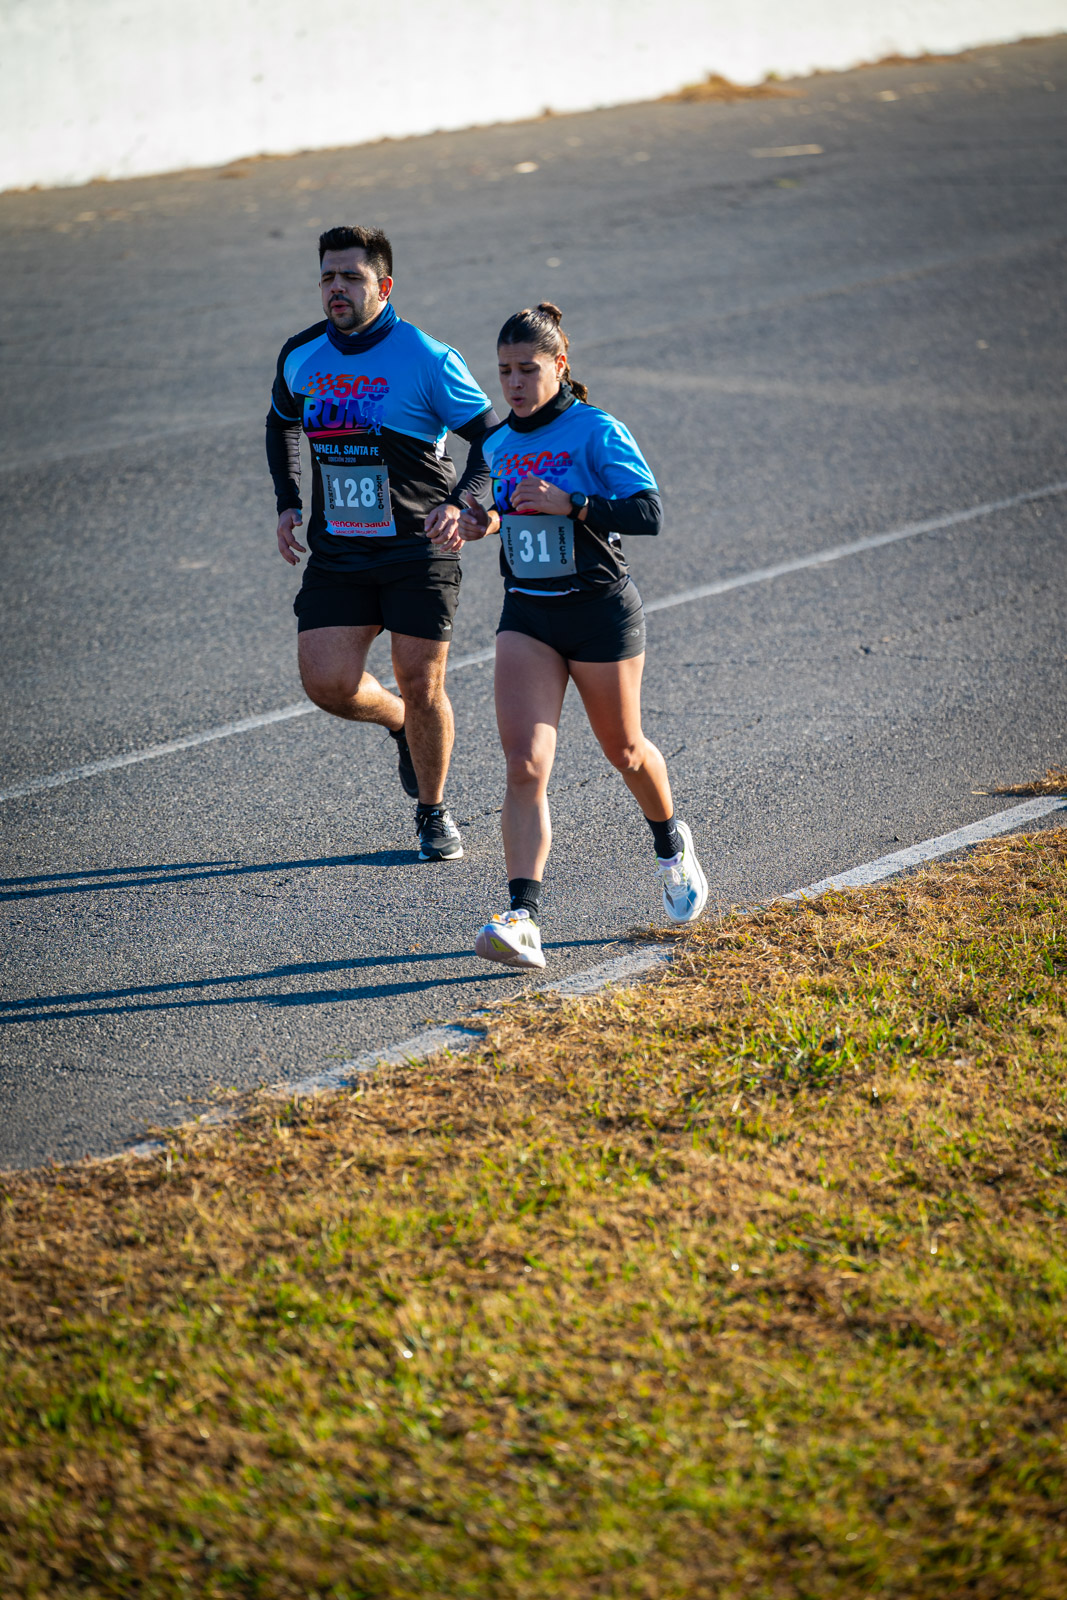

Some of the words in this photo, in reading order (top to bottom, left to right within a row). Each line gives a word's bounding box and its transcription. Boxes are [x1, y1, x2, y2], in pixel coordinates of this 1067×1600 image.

[361, 385, 390, 394] MILLAS
[303, 397, 370, 429] RUN
[343, 444, 369, 456] SANTA
[369, 446, 380, 457] FE
[332, 477, 376, 508] 128
[376, 474, 385, 510] EXACTO
[519, 529, 550, 563] 31
[558, 526, 568, 565] EXACTO
